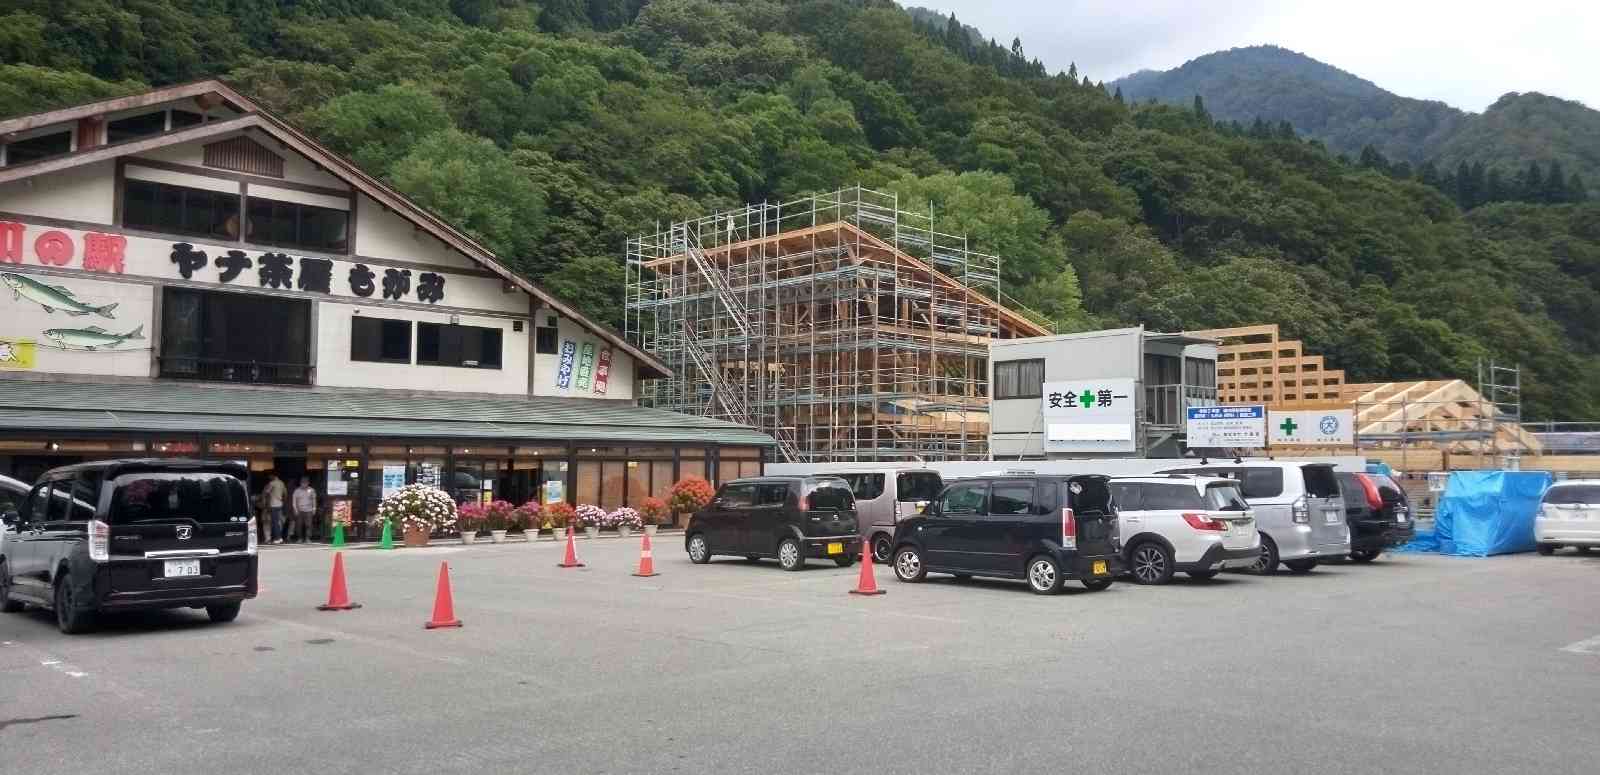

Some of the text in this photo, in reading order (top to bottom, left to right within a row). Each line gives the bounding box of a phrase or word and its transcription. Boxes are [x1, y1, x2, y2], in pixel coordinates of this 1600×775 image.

[170, 242, 334, 295] ヤナ茶屋
[349, 263, 446, 304] もがみ
[558, 342, 575, 386] おみやげ
[1048, 389, 1129, 408] 安全 第一
